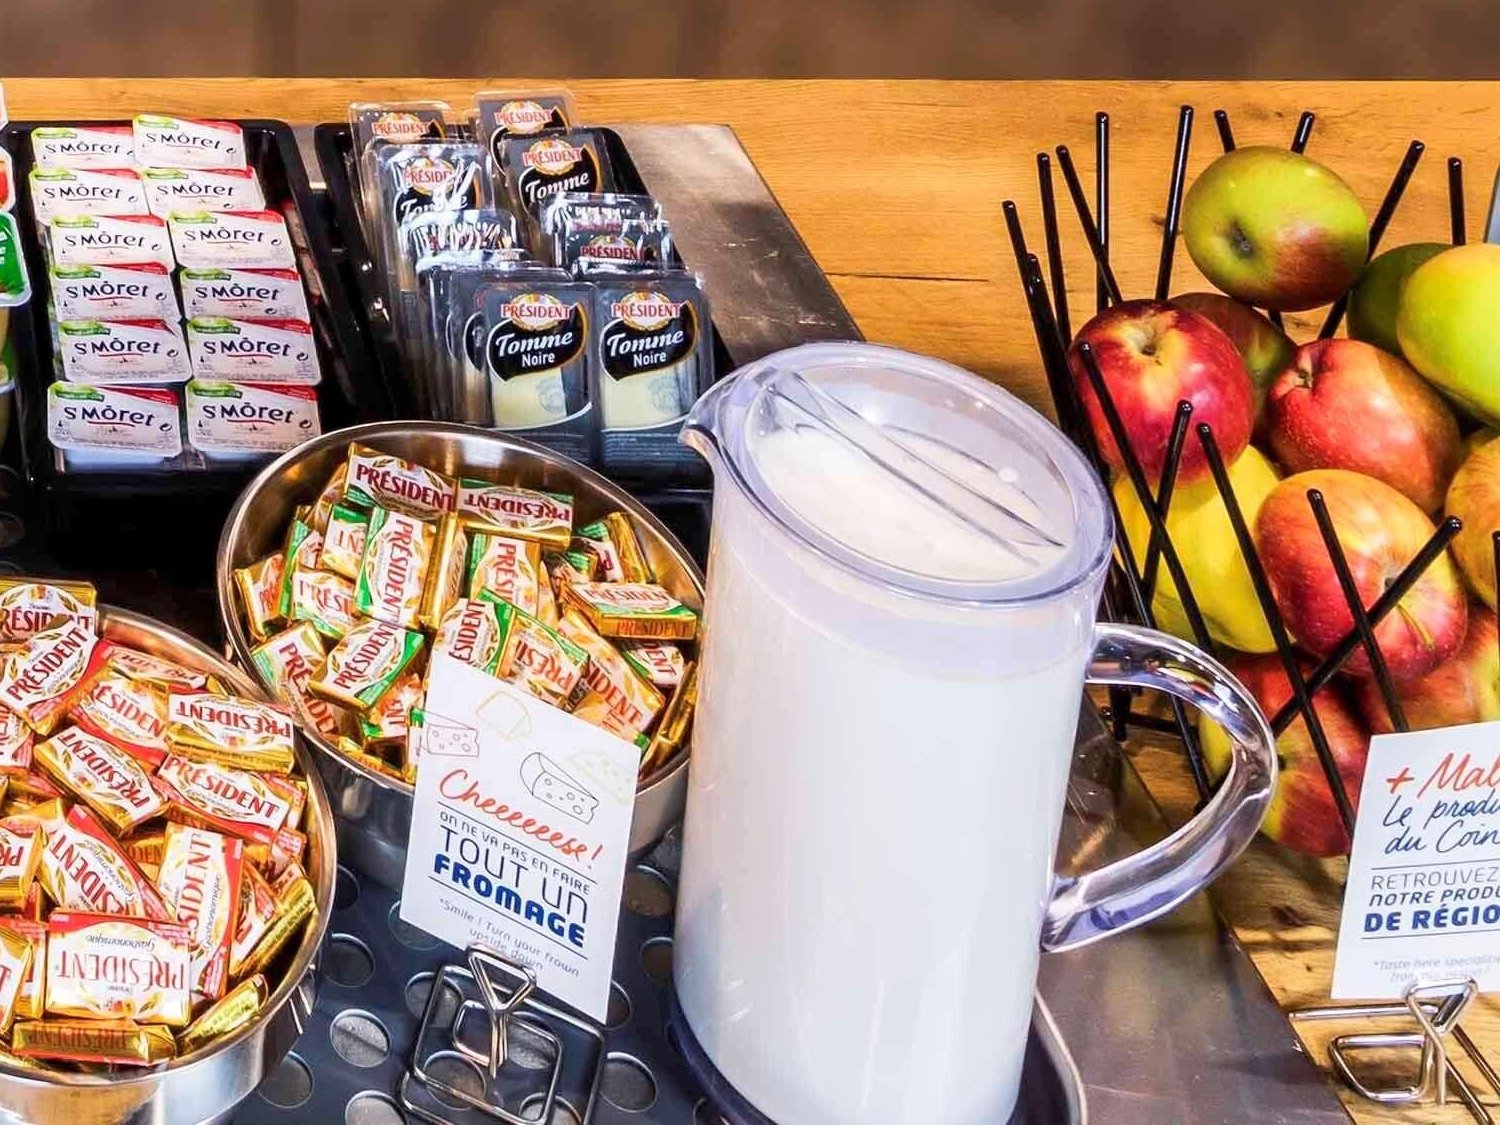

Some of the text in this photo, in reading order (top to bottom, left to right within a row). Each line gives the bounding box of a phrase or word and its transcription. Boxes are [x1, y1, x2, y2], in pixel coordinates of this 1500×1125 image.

[495, 110, 552, 124] PRÉSIDENT
[522, 147, 583, 166] PRÉSIDENT
[525, 171, 590, 203] Tomme
[501, 302, 572, 320] PRÉSIDENT
[612, 302, 681, 318] PRÉSIDENT
[495, 331, 574, 358] Tomme
[607, 328, 684, 356] Tomme
[521, 351, 555, 368] Noire
[633, 351, 667, 368] Noire
[356, 463, 456, 513] PRÉSIDENT
[463, 492, 570, 523] PRÉSIDENT
[382, 518, 414, 625] PRÉSIDENT
[5, 626, 92, 702] PRÉSIDENT
[333, 620, 396, 691] PRÉSIDENT
[176, 698, 292, 739] PRÉSIDENT
[165, 754, 280, 818] PRÉSIDENT
[1382, 795, 1413, 827] Le
[1385, 819, 1500, 854] du Coin
[440, 811, 590, 895] ON NE VA PAS EN FAIRE
[440, 825, 588, 923] TOUT UN
[1371, 867, 1499, 890] RETROUVEZ
[434, 854, 585, 948] FROMAGE
[1369, 890, 1435, 907] NOTRE
[1364, 912, 1402, 932] DE
[57, 949, 186, 991] PRÉSIDENT
